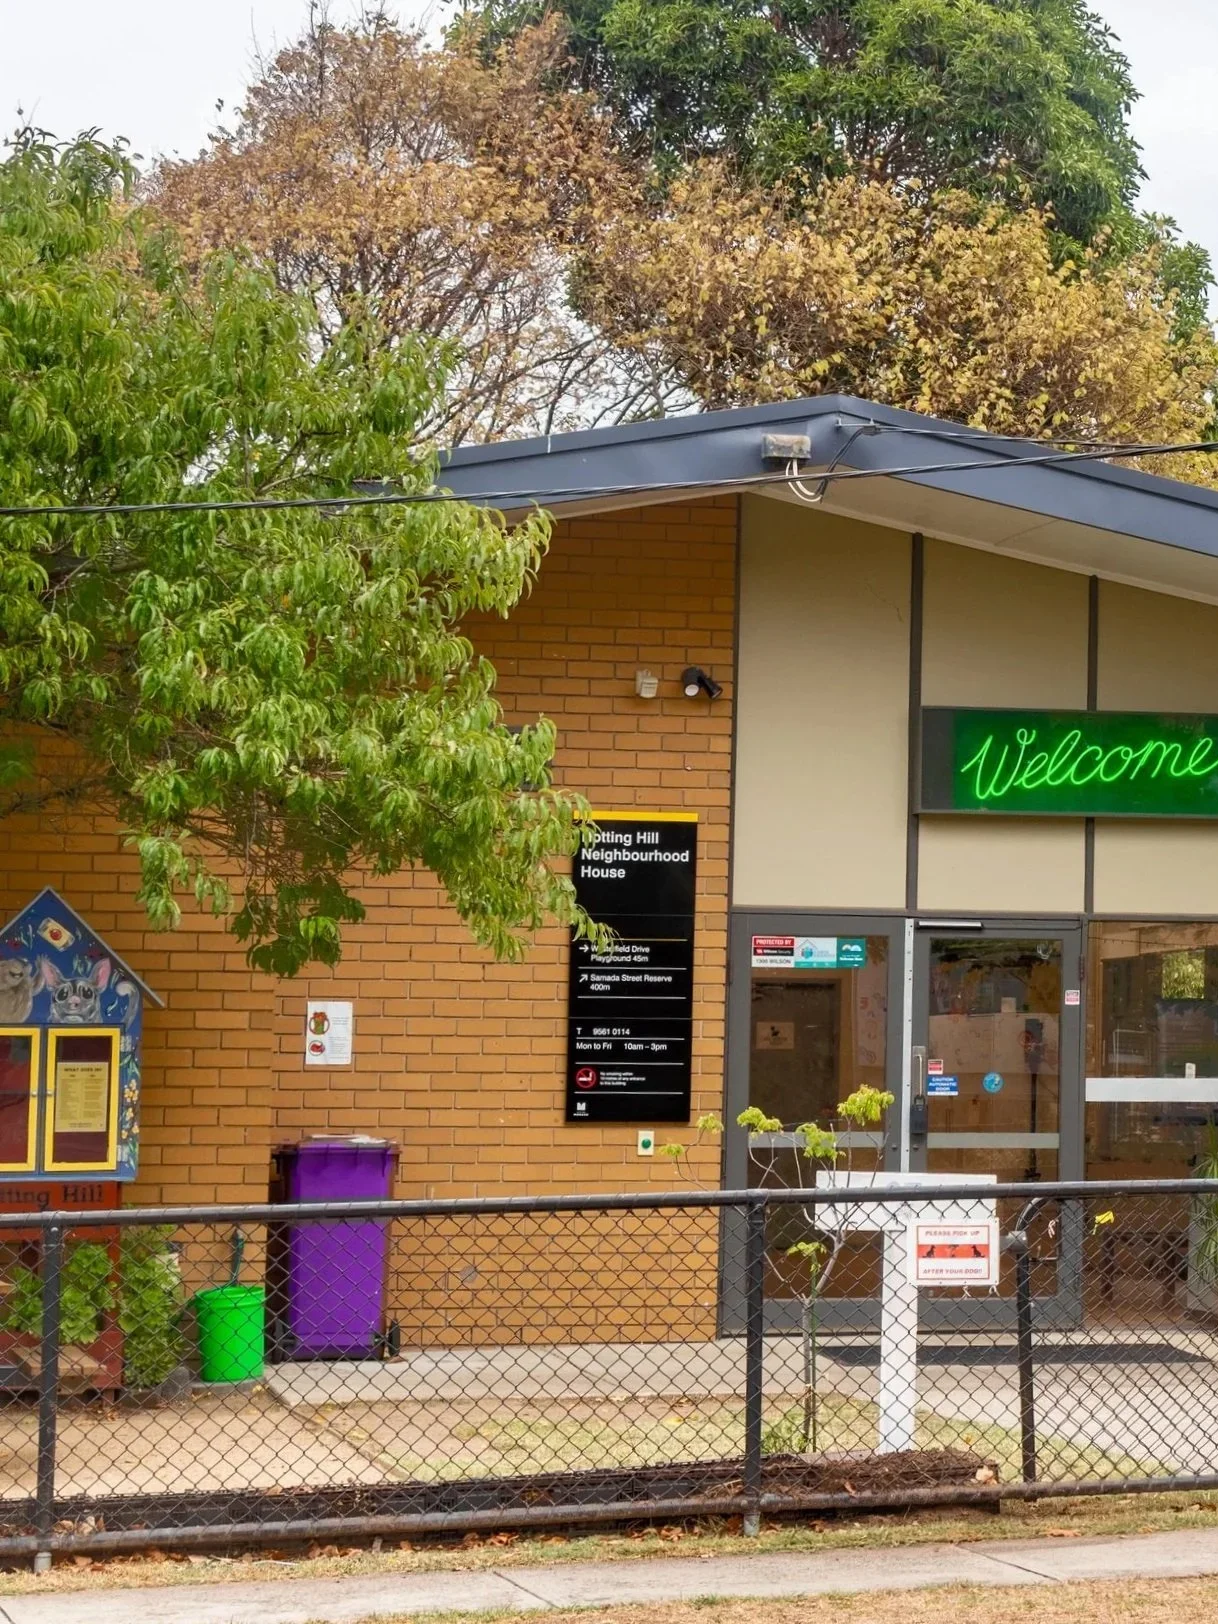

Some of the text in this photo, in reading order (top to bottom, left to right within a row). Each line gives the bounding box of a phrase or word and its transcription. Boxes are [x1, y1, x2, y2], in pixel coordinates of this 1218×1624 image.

[636, 831, 660, 844] Hill
[581, 848, 690, 863] Neighbourhood
[580, 865, 626, 878] House
[631, 945, 651, 953] Drive
[590, 954, 632, 963] Playground
[621, 974, 643, 982] Street
[643, 974, 673, 982] Reserve
[590, 983, 611, 991] 400m
[576, 1027, 582, 1035] T
[576, 1042, 592, 1050] Mon
[593, 1042, 601, 1050] to
[602, 1042, 613, 1050] Fri
[624, 1043, 644, 1051] 10am
[650, 1043, 667, 1052] 3pm
[63, 1184, 105, 1203] Hill
